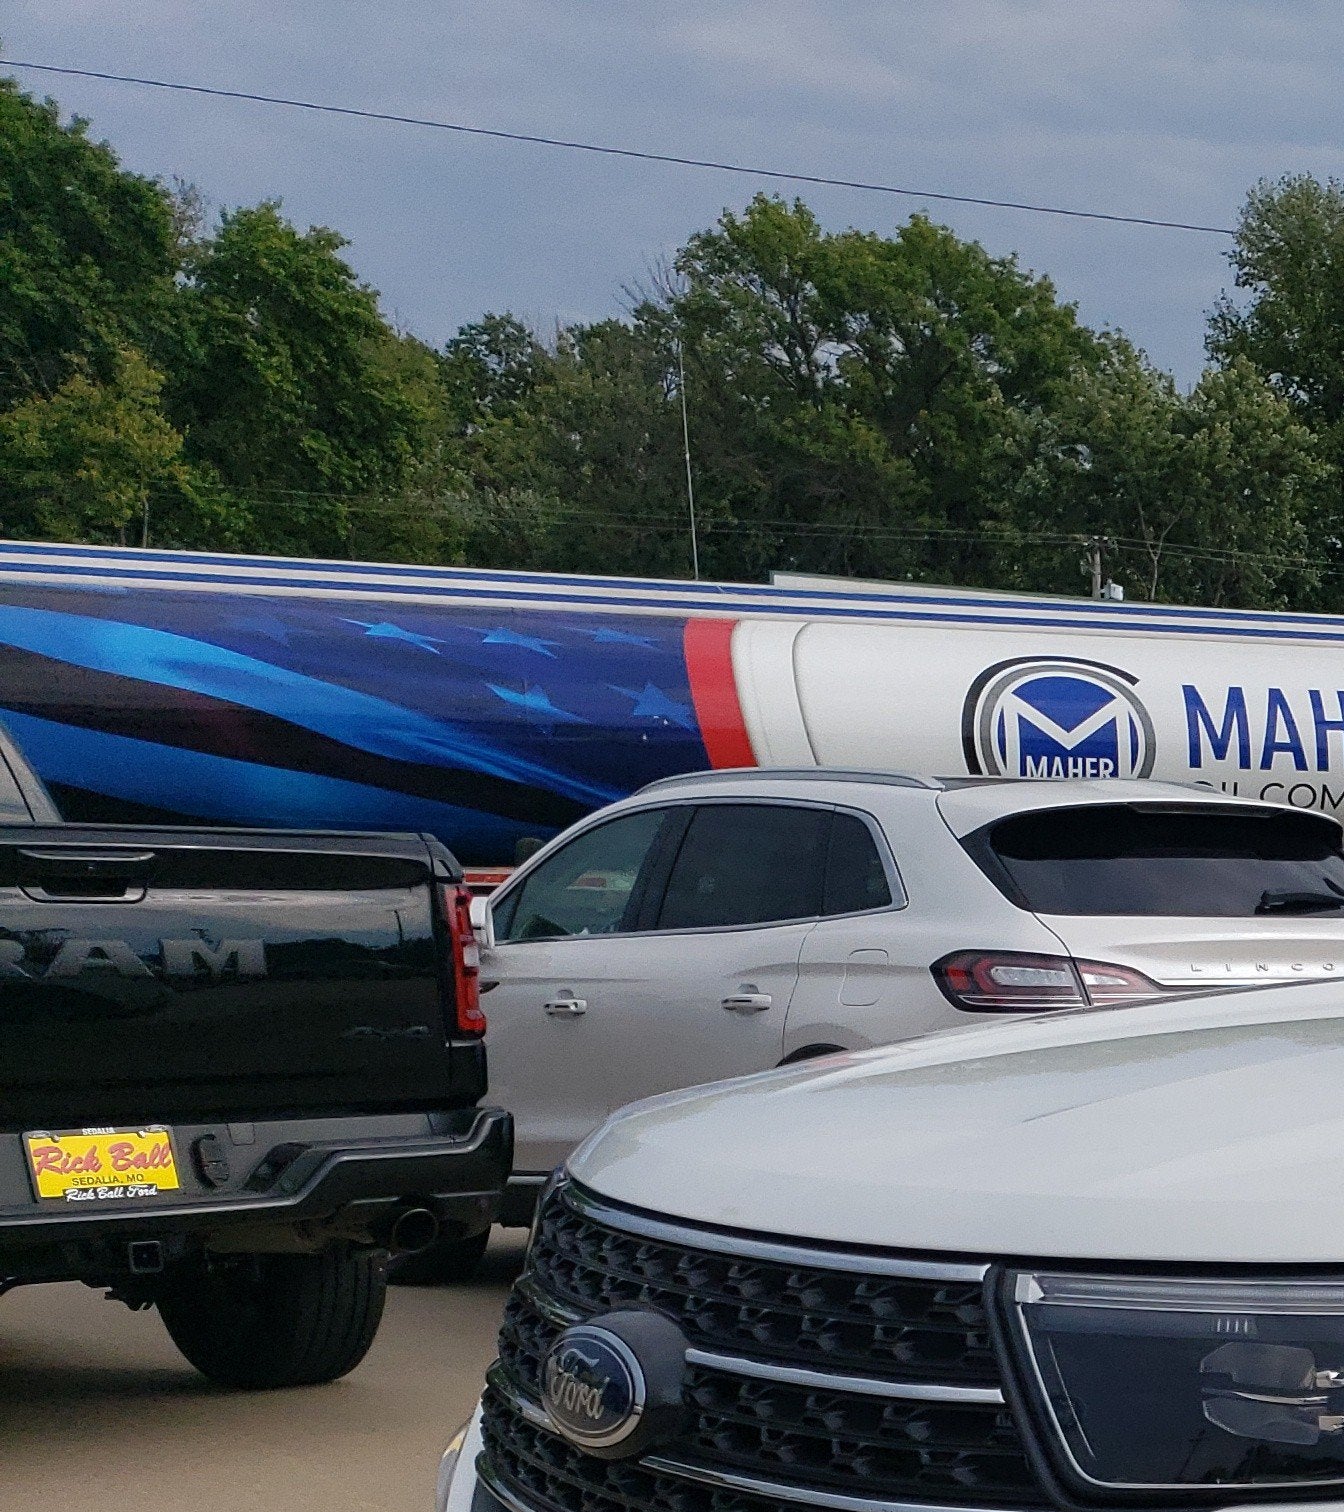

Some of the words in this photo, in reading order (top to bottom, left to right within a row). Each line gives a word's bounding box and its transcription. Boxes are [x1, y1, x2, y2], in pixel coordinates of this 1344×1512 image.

[1026, 755, 1114, 779] MAHER
[33, 1145, 103, 1176] Rick
[108, 1142, 171, 1171] Ball
[72, 1175, 124, 1186] SEDALIA,
[126, 1173, 144, 1183] MO
[65, 1188, 96, 1203] Rick
[97, 1186, 124, 1199] Ball
[126, 1184, 158, 1198] Ford
[547, 1348, 610, 1420] Ford
